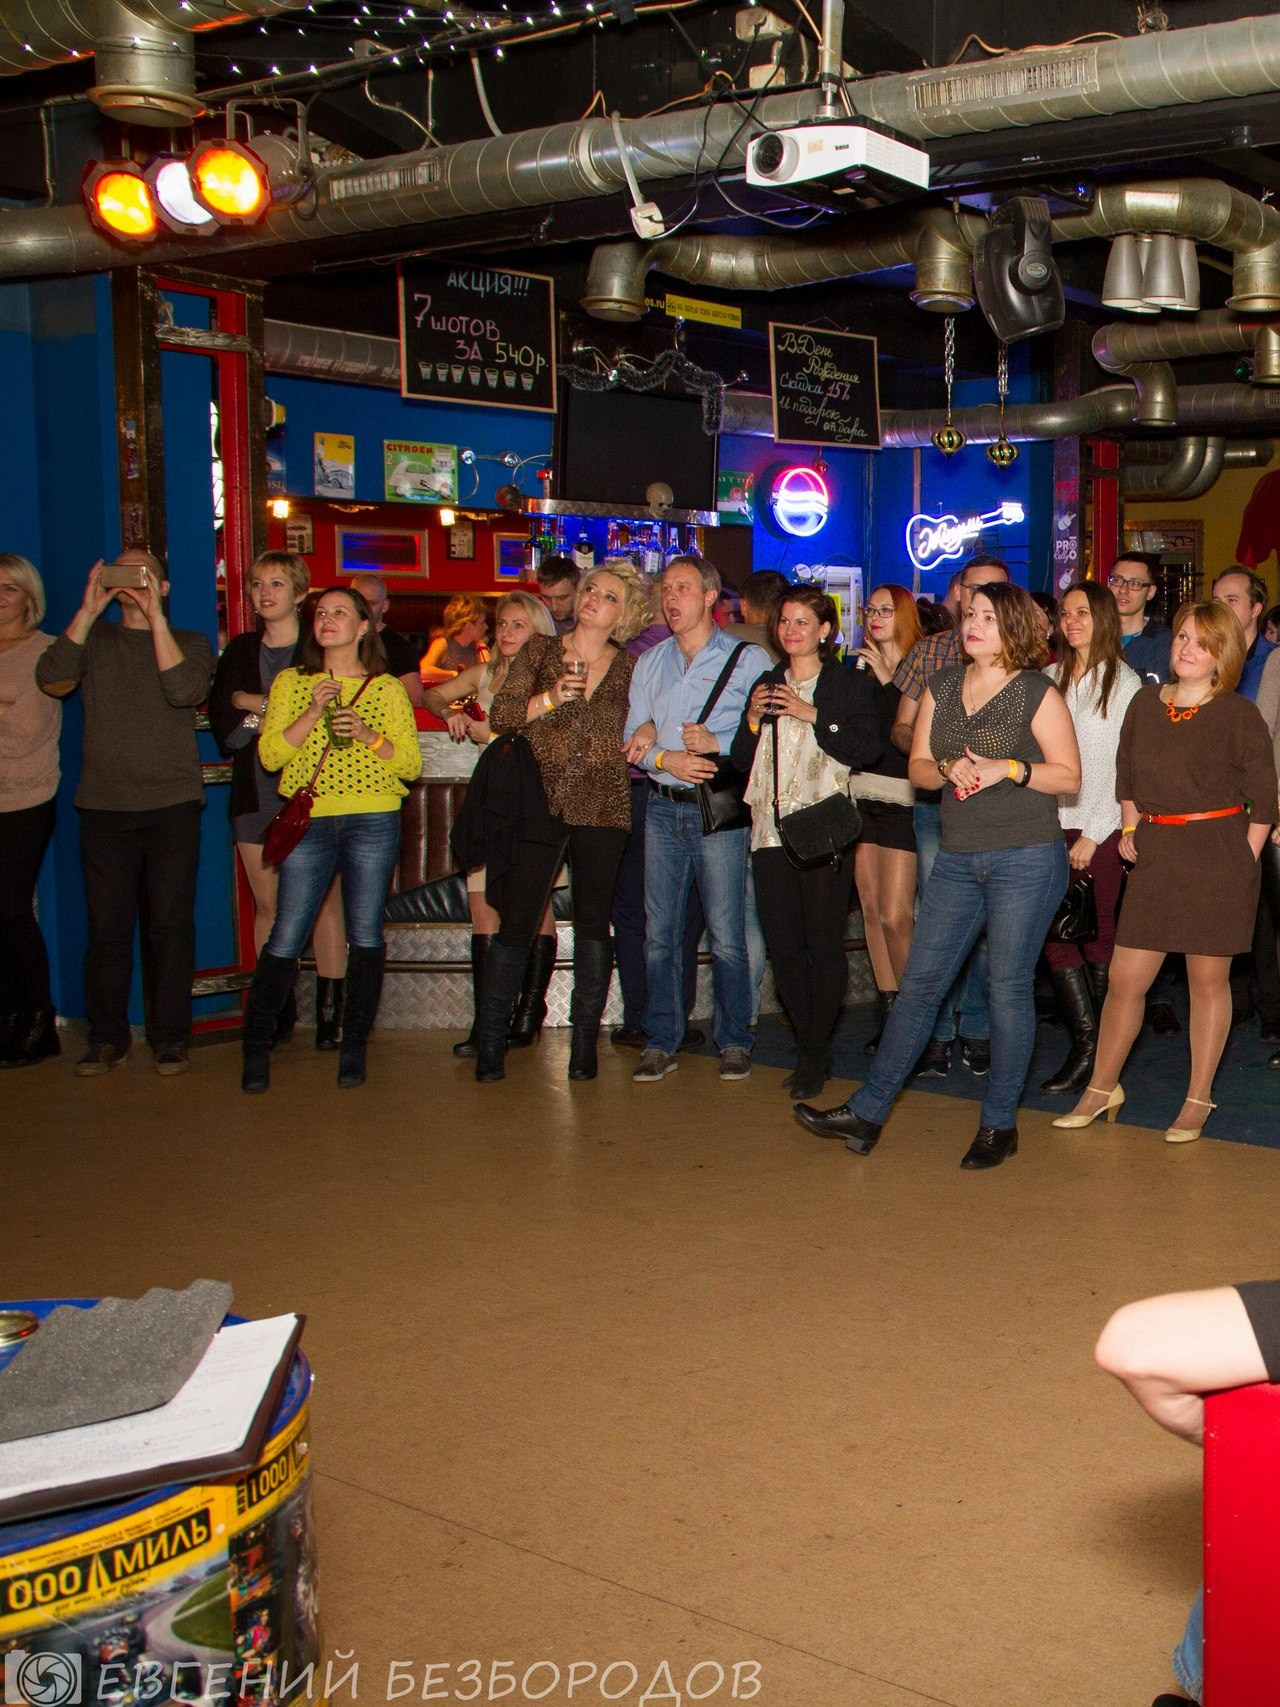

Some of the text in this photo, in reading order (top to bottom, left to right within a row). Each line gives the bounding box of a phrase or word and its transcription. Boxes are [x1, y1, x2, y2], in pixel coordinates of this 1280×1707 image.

[447, 270, 530, 298] АКЦИЯ!!!
[414, 293, 431, 328] 7
[644, 297, 665, 309] es.ru
[455, 340, 483, 361] ЗА
[826, 381, 851, 400] 15%
[8, 1565, 81, 1610] 000
[113, 1516, 209, 1579] МИЛЬ
